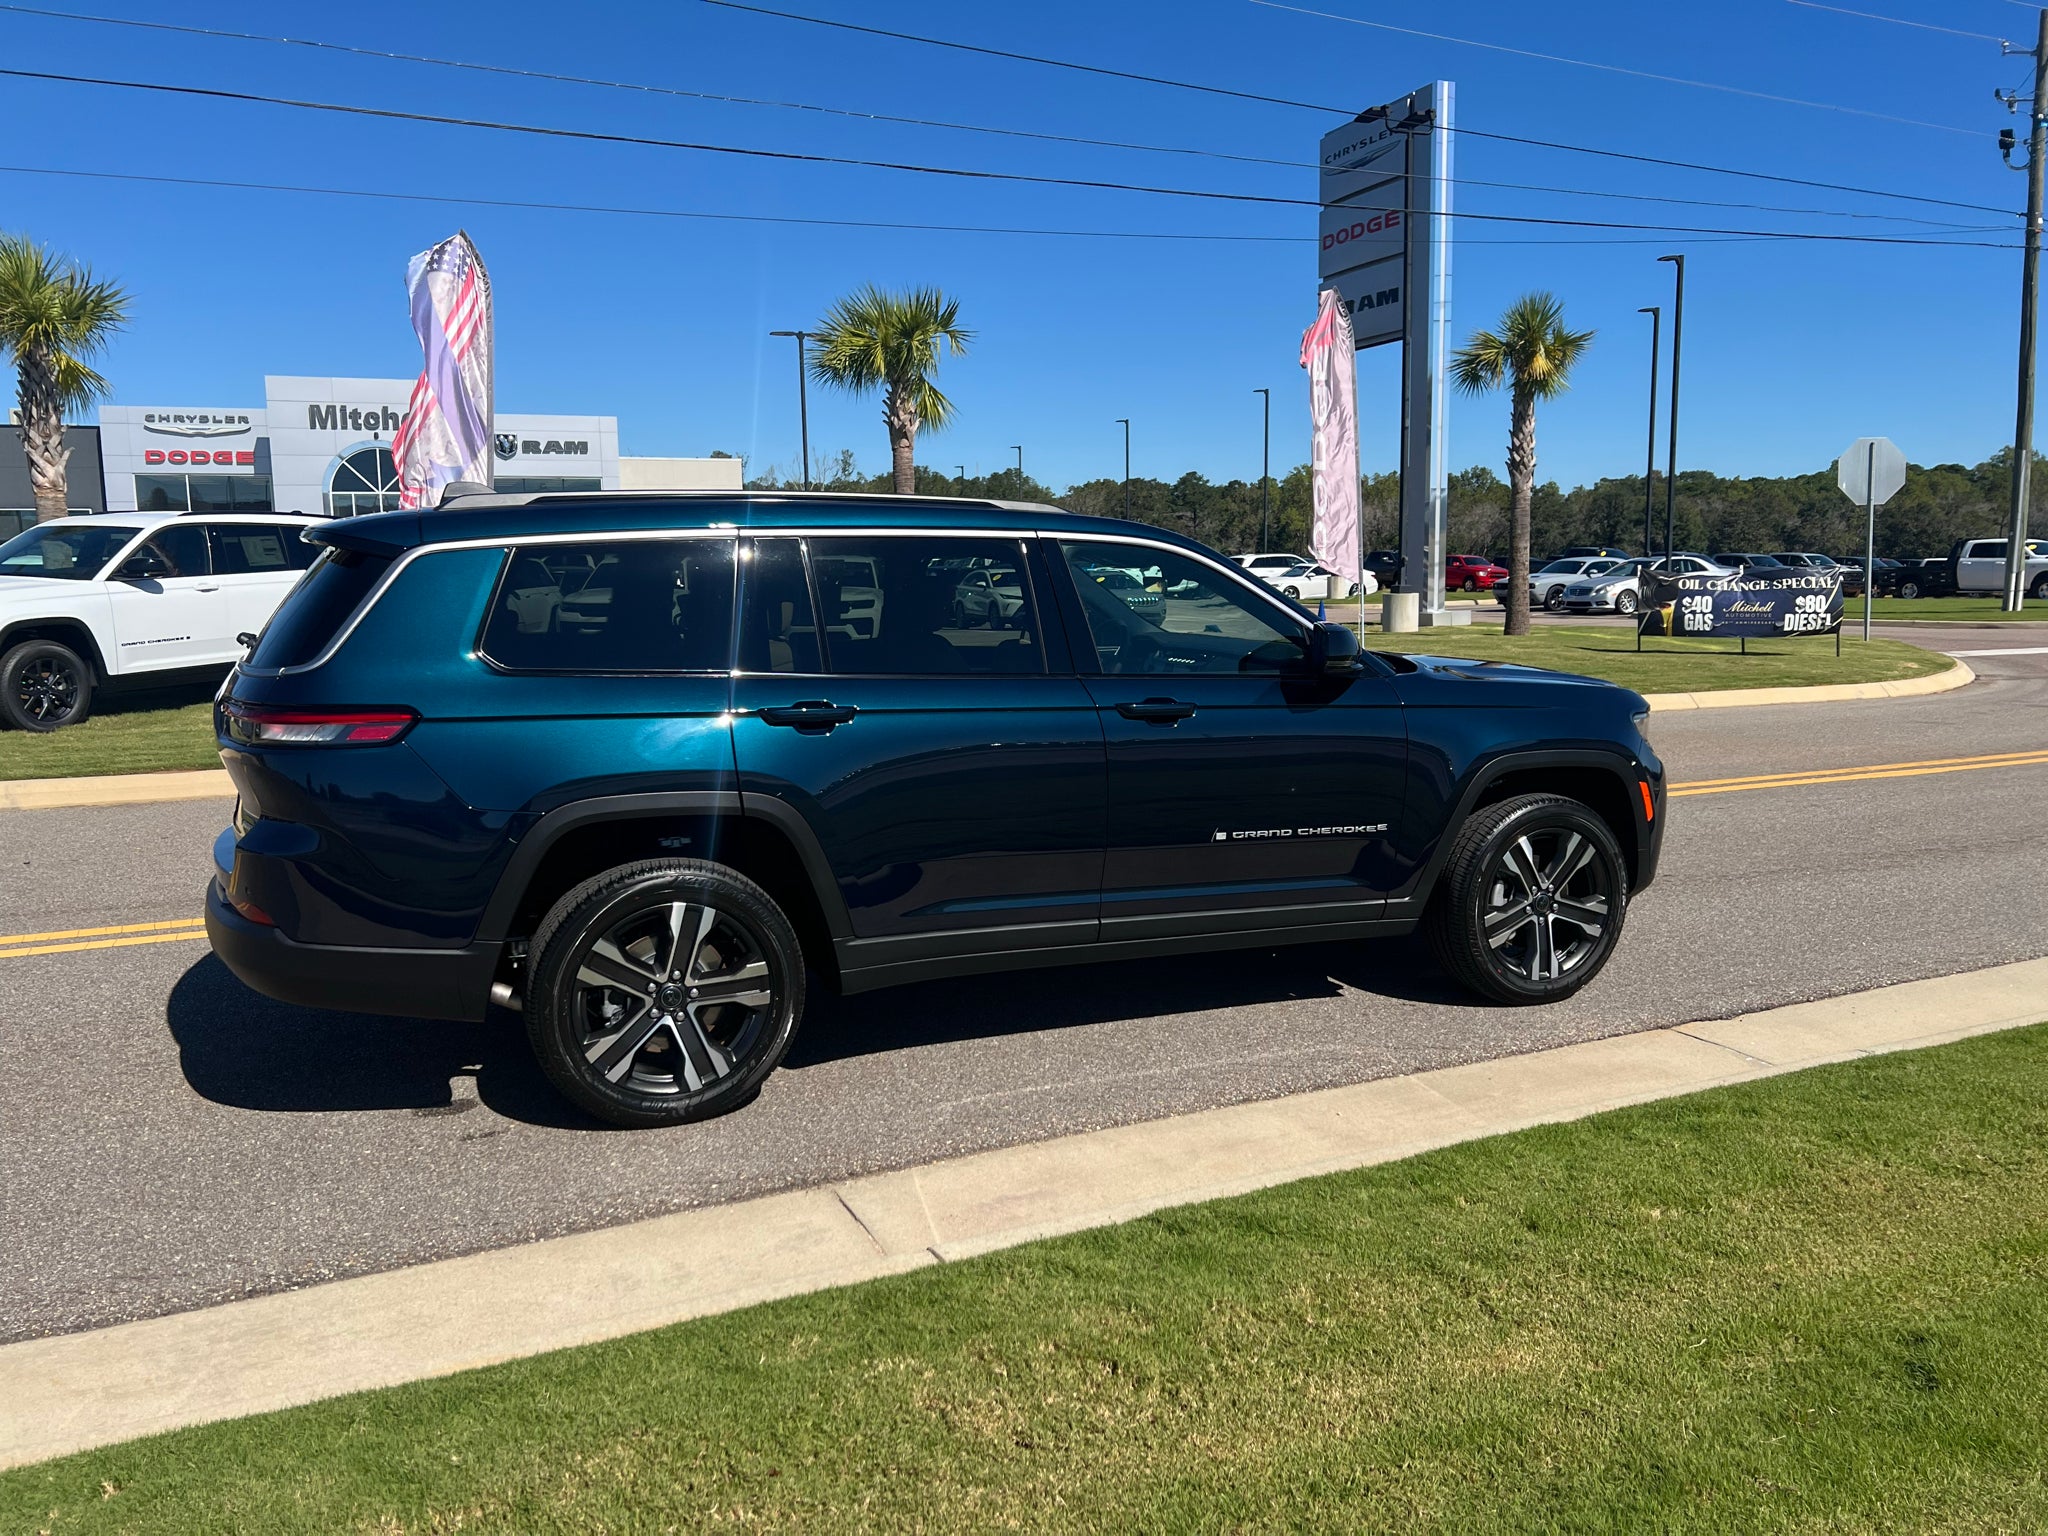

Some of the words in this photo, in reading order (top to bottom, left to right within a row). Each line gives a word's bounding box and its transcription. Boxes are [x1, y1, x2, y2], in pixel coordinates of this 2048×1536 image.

[1322, 209, 1400, 250] DODGE
[144, 413, 250, 425] CHRYSLER
[521, 440, 589, 456] RAM
[144, 449, 255, 467] DODGE
[1678, 578, 1704, 590] OIL
[1706, 579, 1770, 592] CHANGE
[1772, 575, 1836, 590] SPECIAL
[1681, 595, 1713, 614] $40
[1722, 600, 1775, 612] Mitchell
[1794, 594, 1827, 614] $80
[1683, 613, 1714, 632] GAS
[1783, 613, 1832, 632] DIESEL
[1232, 829, 1292, 839] GRAND
[1297, 823, 1388, 835] CHEROKEE
